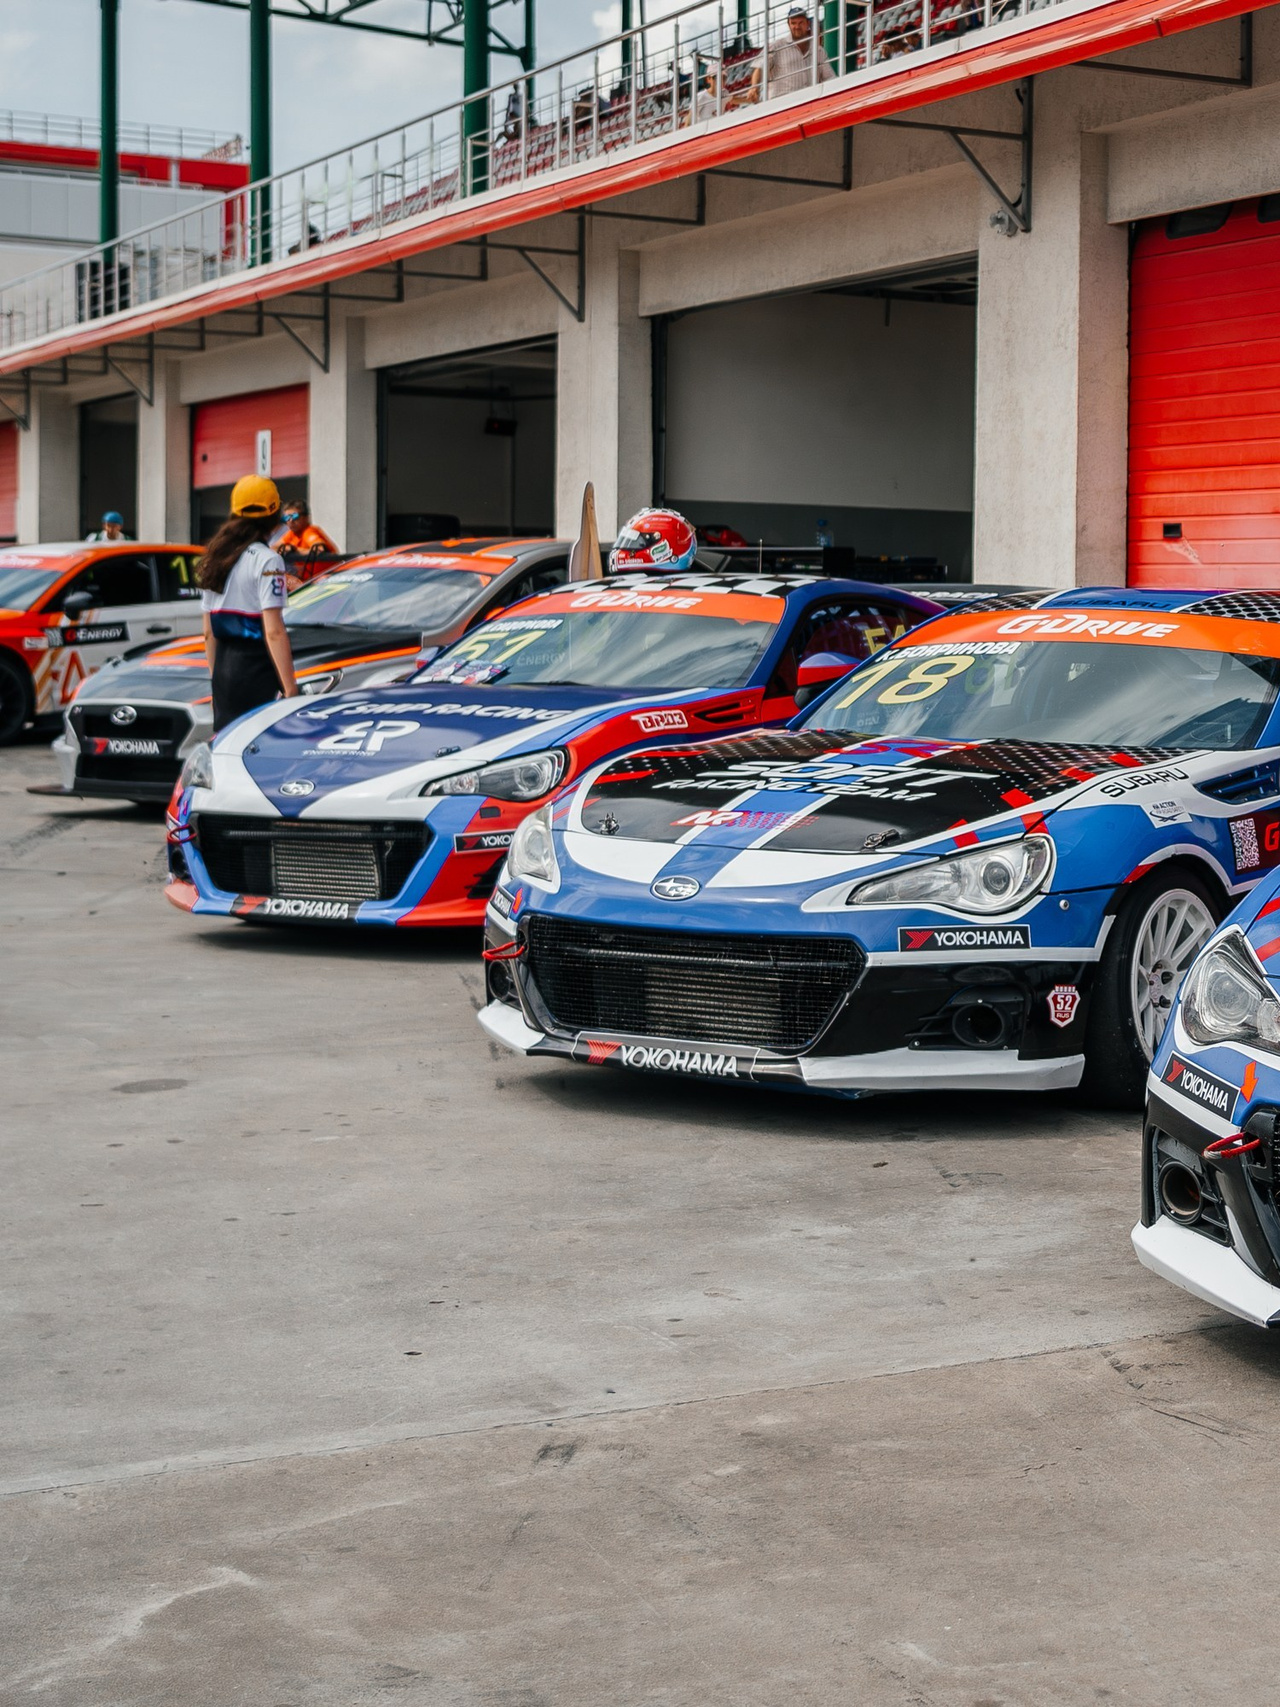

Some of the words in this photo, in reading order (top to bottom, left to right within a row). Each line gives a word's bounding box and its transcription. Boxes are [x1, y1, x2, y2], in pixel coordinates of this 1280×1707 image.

[448, 630, 547, 664] 51
[875, 641, 1022, 663] К.БОЯРИНОВА
[835, 655, 976, 710] 18
[342, 703, 431, 715] SMP
[424, 703, 573, 720] RACING
[108, 739, 160, 754] YOKOHAMA
[697, 761, 1001, 787] SOFIT
[1100, 768, 1190, 798] SUBARU
[652, 778, 806, 792] RACING
[806, 781, 937, 801] TEAM
[1159, 801, 1177, 809] ACTION
[265, 898, 349, 919] YOKOHAMA
[934, 930, 1025, 947] YOKOHAMA
[1056, 995, 1073, 1011] 52
[620, 1045, 739, 1078] YOKOHAMA
[1179, 1068, 1230, 1112] YOKOHAMA
